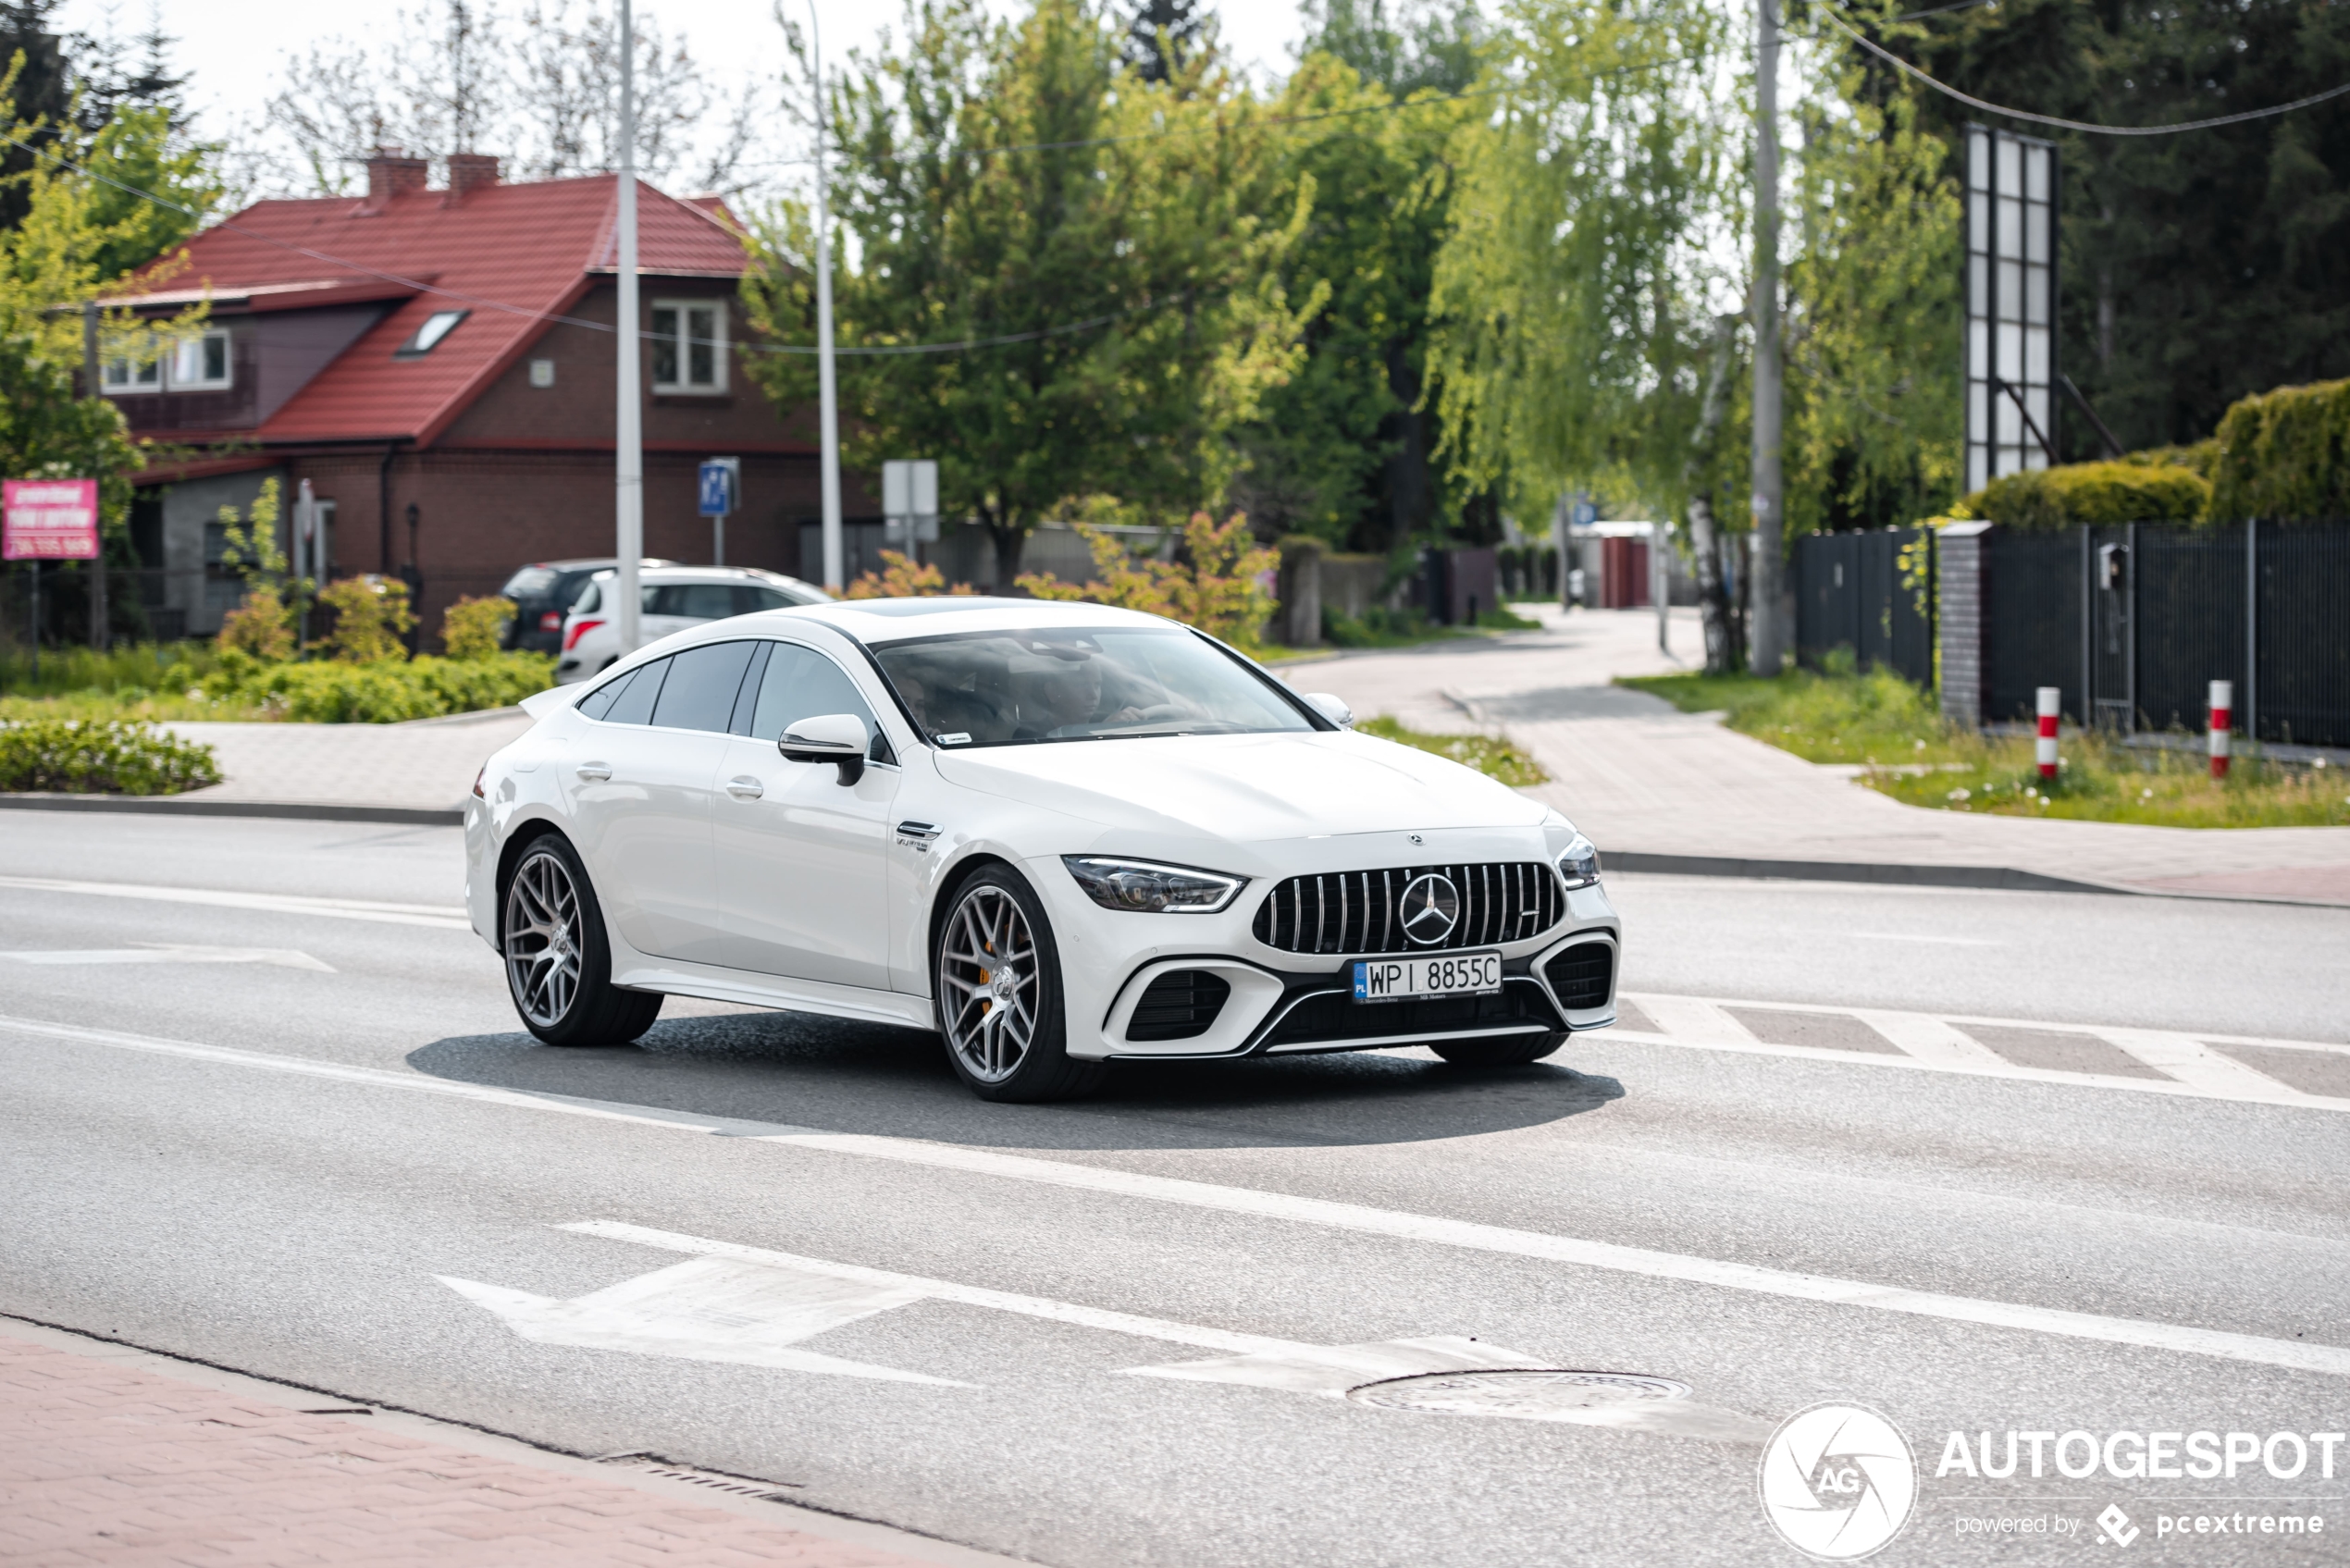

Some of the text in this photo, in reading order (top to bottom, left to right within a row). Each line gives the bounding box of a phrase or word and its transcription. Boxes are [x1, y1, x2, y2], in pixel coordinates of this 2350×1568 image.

[1369, 957, 1497, 994] WPI 8855C
[1355, 984, 1366, 994] PL
